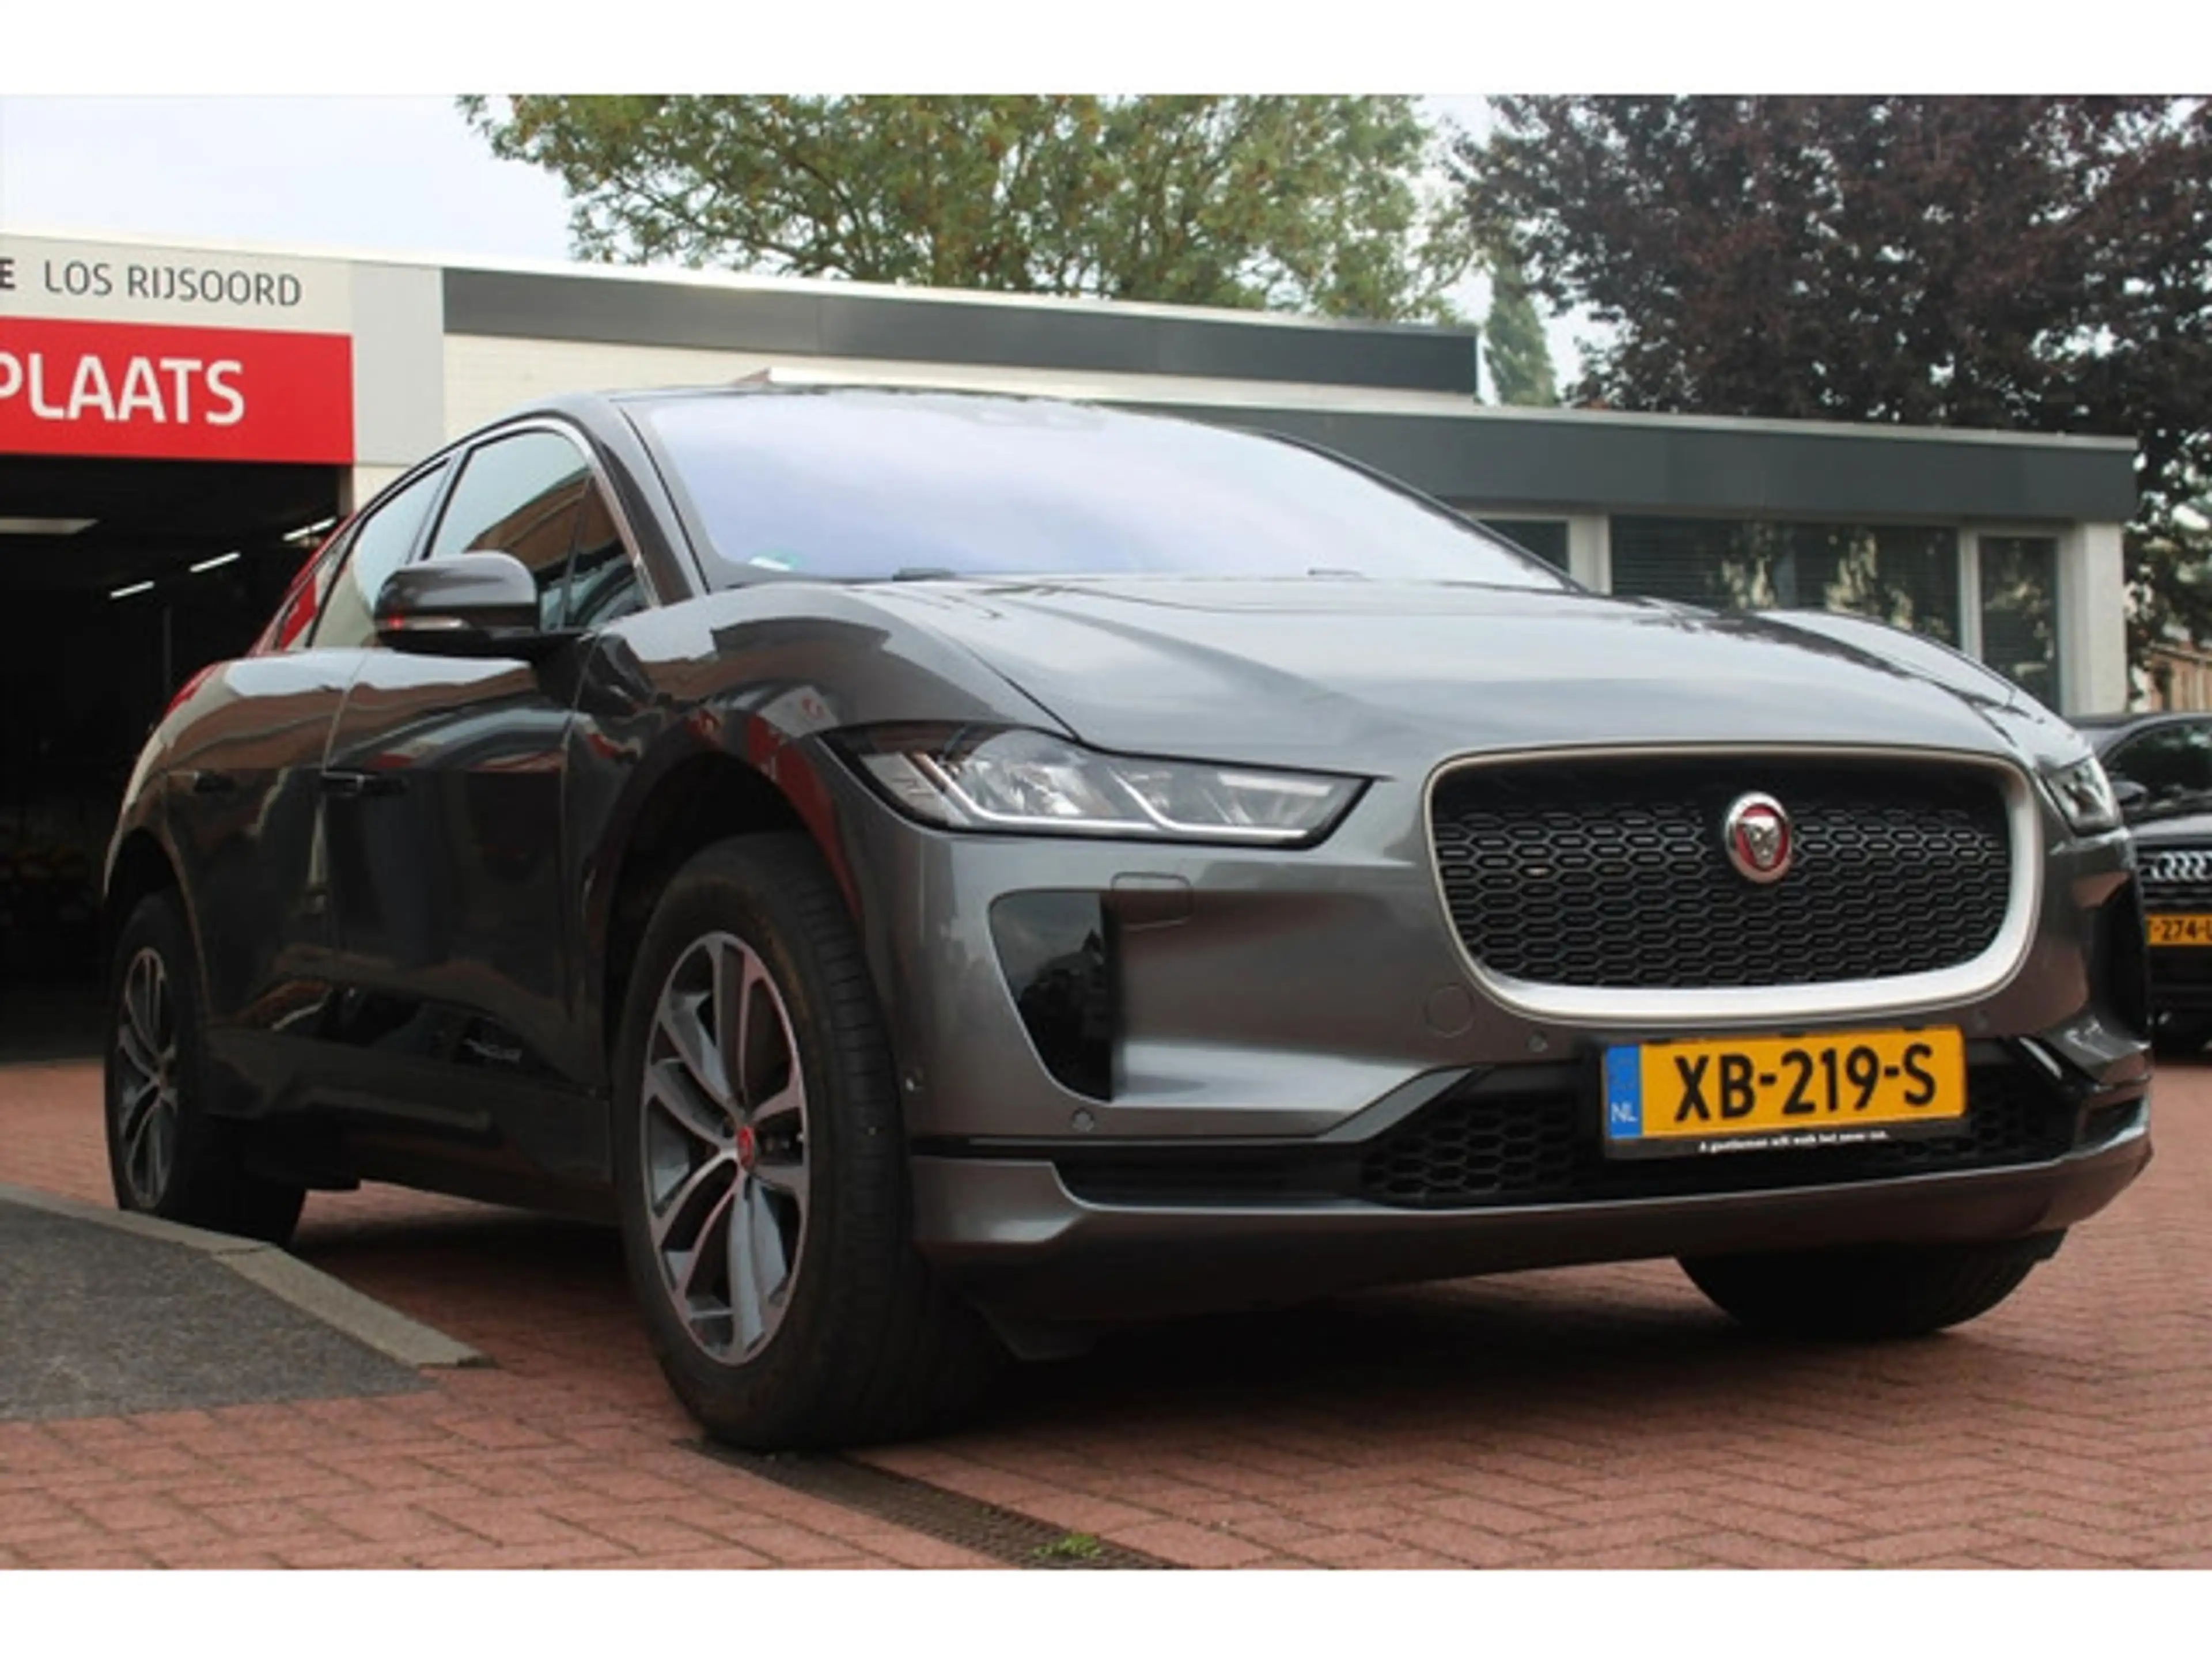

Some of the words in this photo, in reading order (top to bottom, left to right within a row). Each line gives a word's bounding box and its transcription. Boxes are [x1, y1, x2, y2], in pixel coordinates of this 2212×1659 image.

[44, 259, 113, 296] LOS
[127, 266, 302, 306] RIJSOORD
[1674, 1043, 1937, 1122] XB-219-S
[1611, 1103, 1638, 1123] NL
